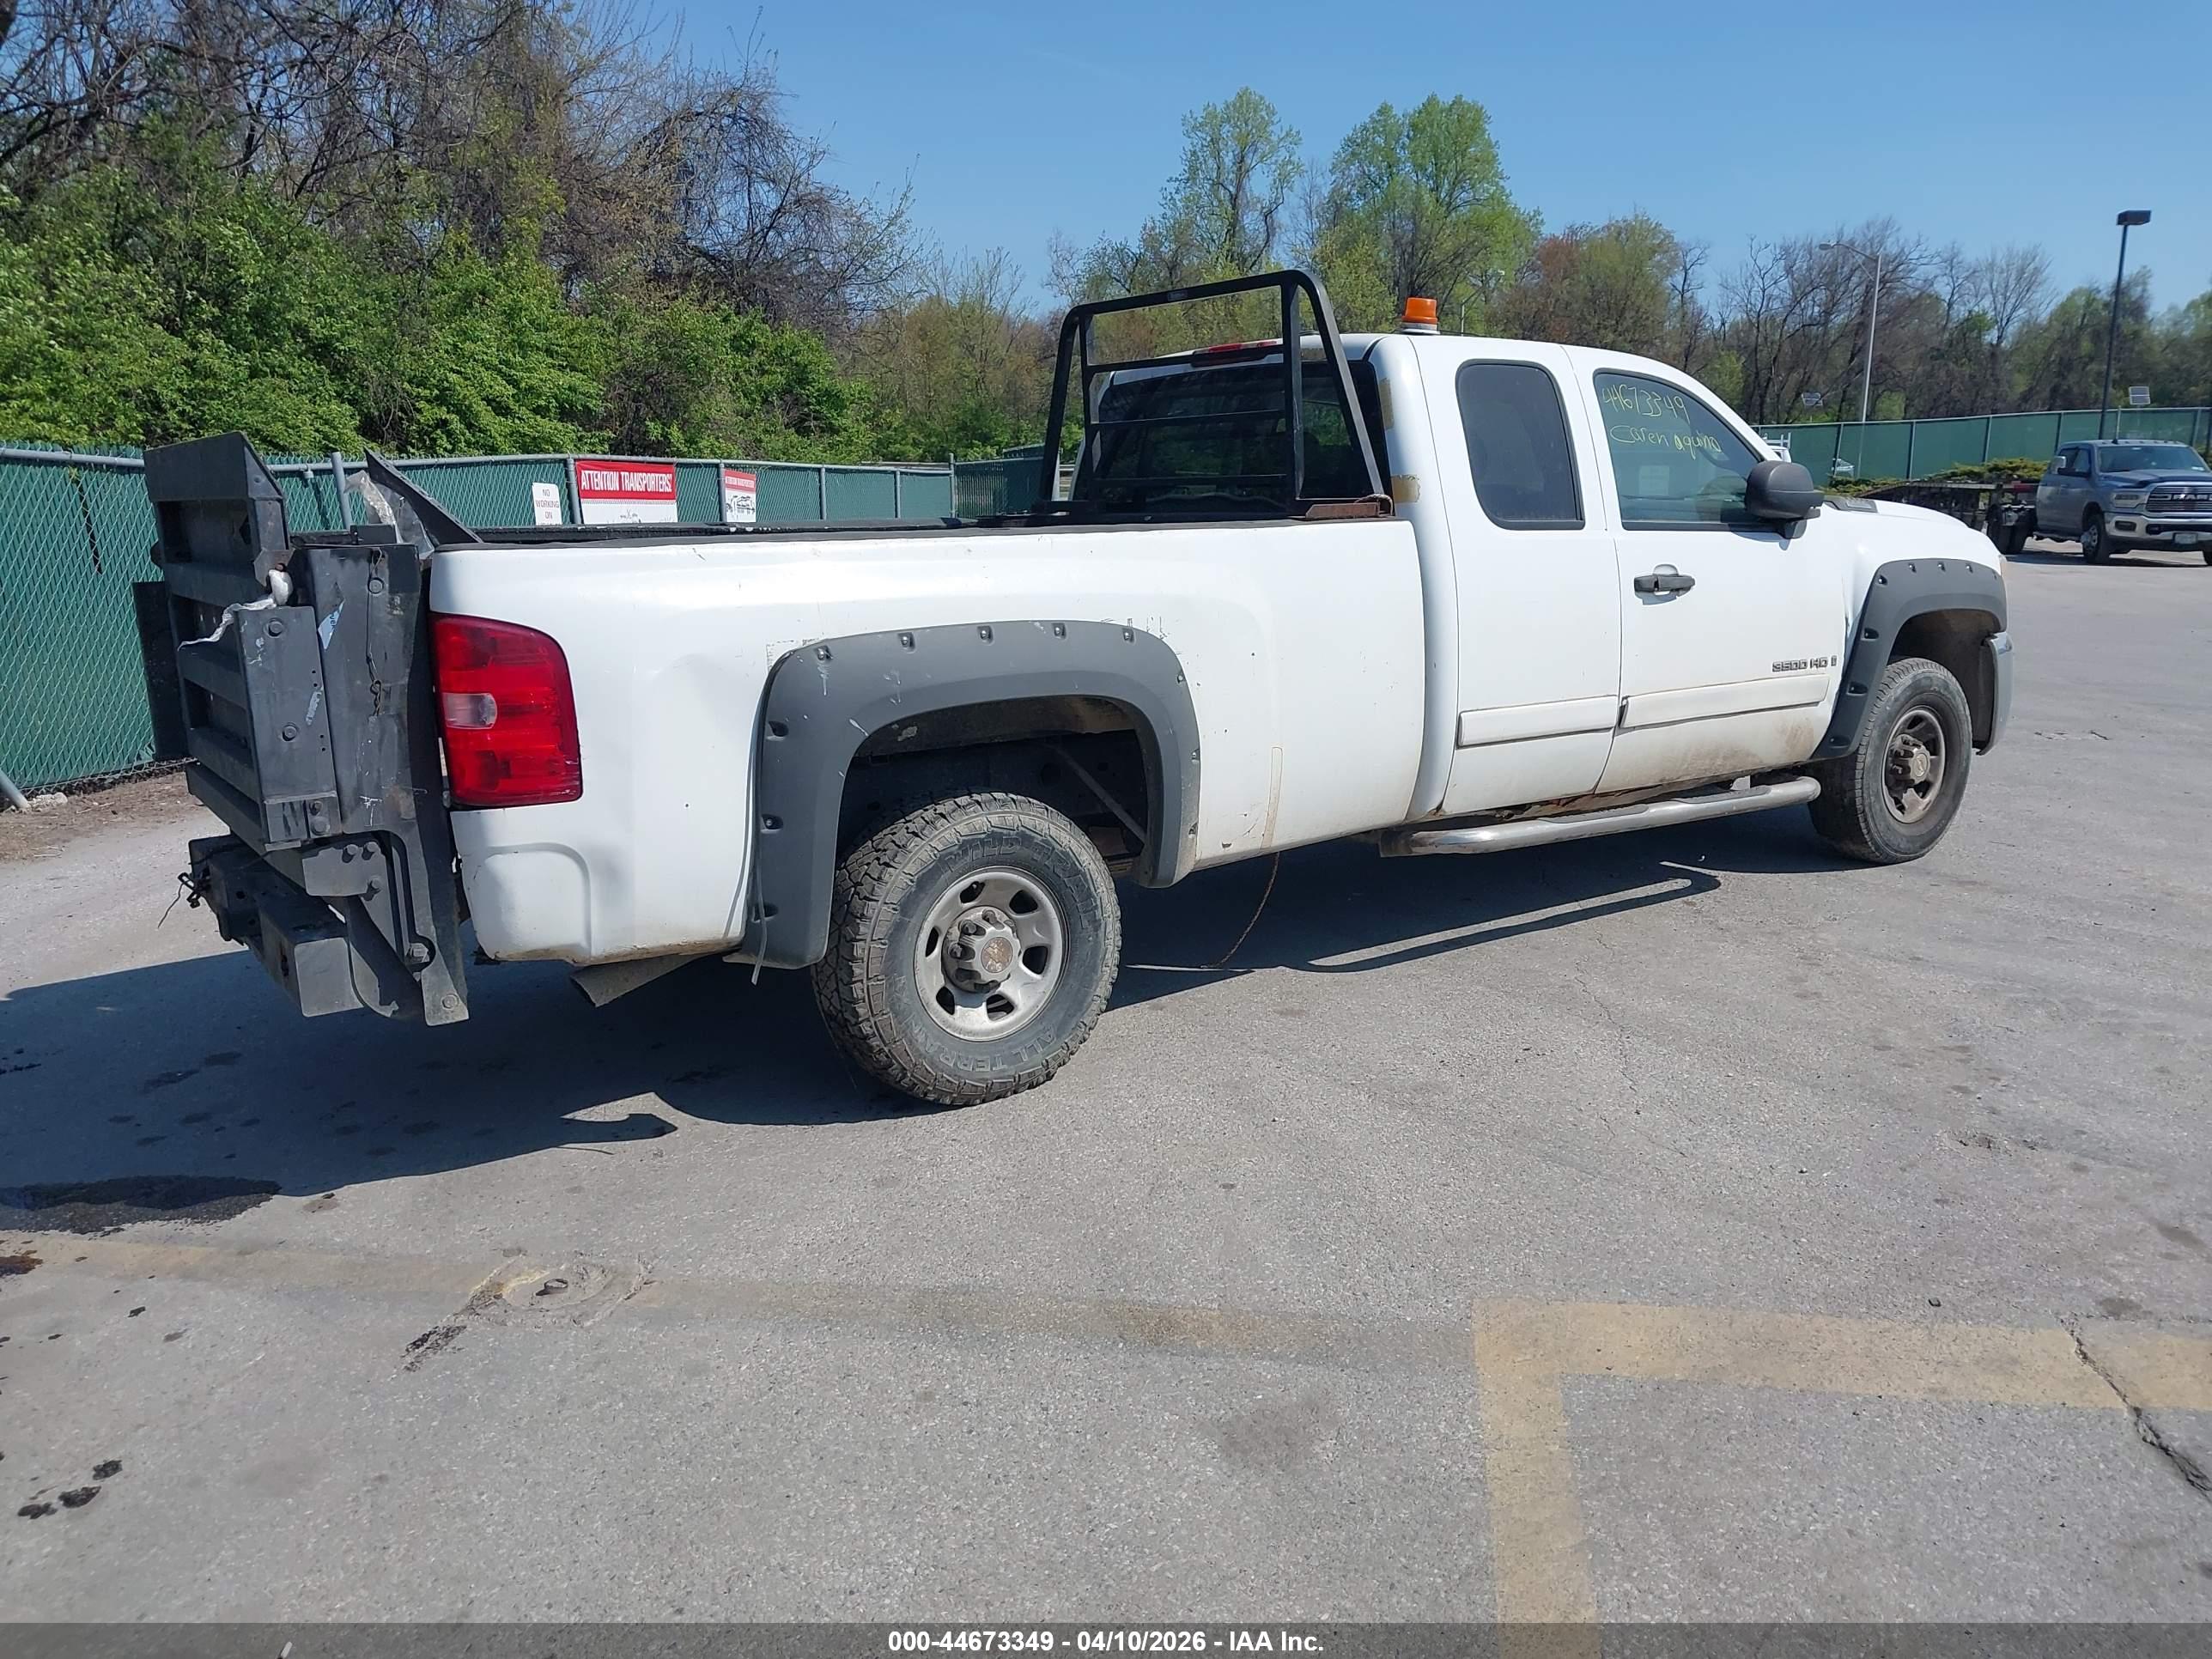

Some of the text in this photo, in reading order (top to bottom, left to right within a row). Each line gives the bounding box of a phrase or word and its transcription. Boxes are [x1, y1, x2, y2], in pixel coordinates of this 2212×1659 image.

[1601, 384, 1691, 425] 44673349
[1609, 424, 1670, 447] Caren
[580, 470, 620, 491] ATTENTION
[542, 489, 550, 497] NO
[535, 500, 560, 508] WORKING
[544, 511, 553, 520] ON
[1771, 657, 1828, 672] 3500 HD
[1012, 1023, 1058, 1061] ALL
